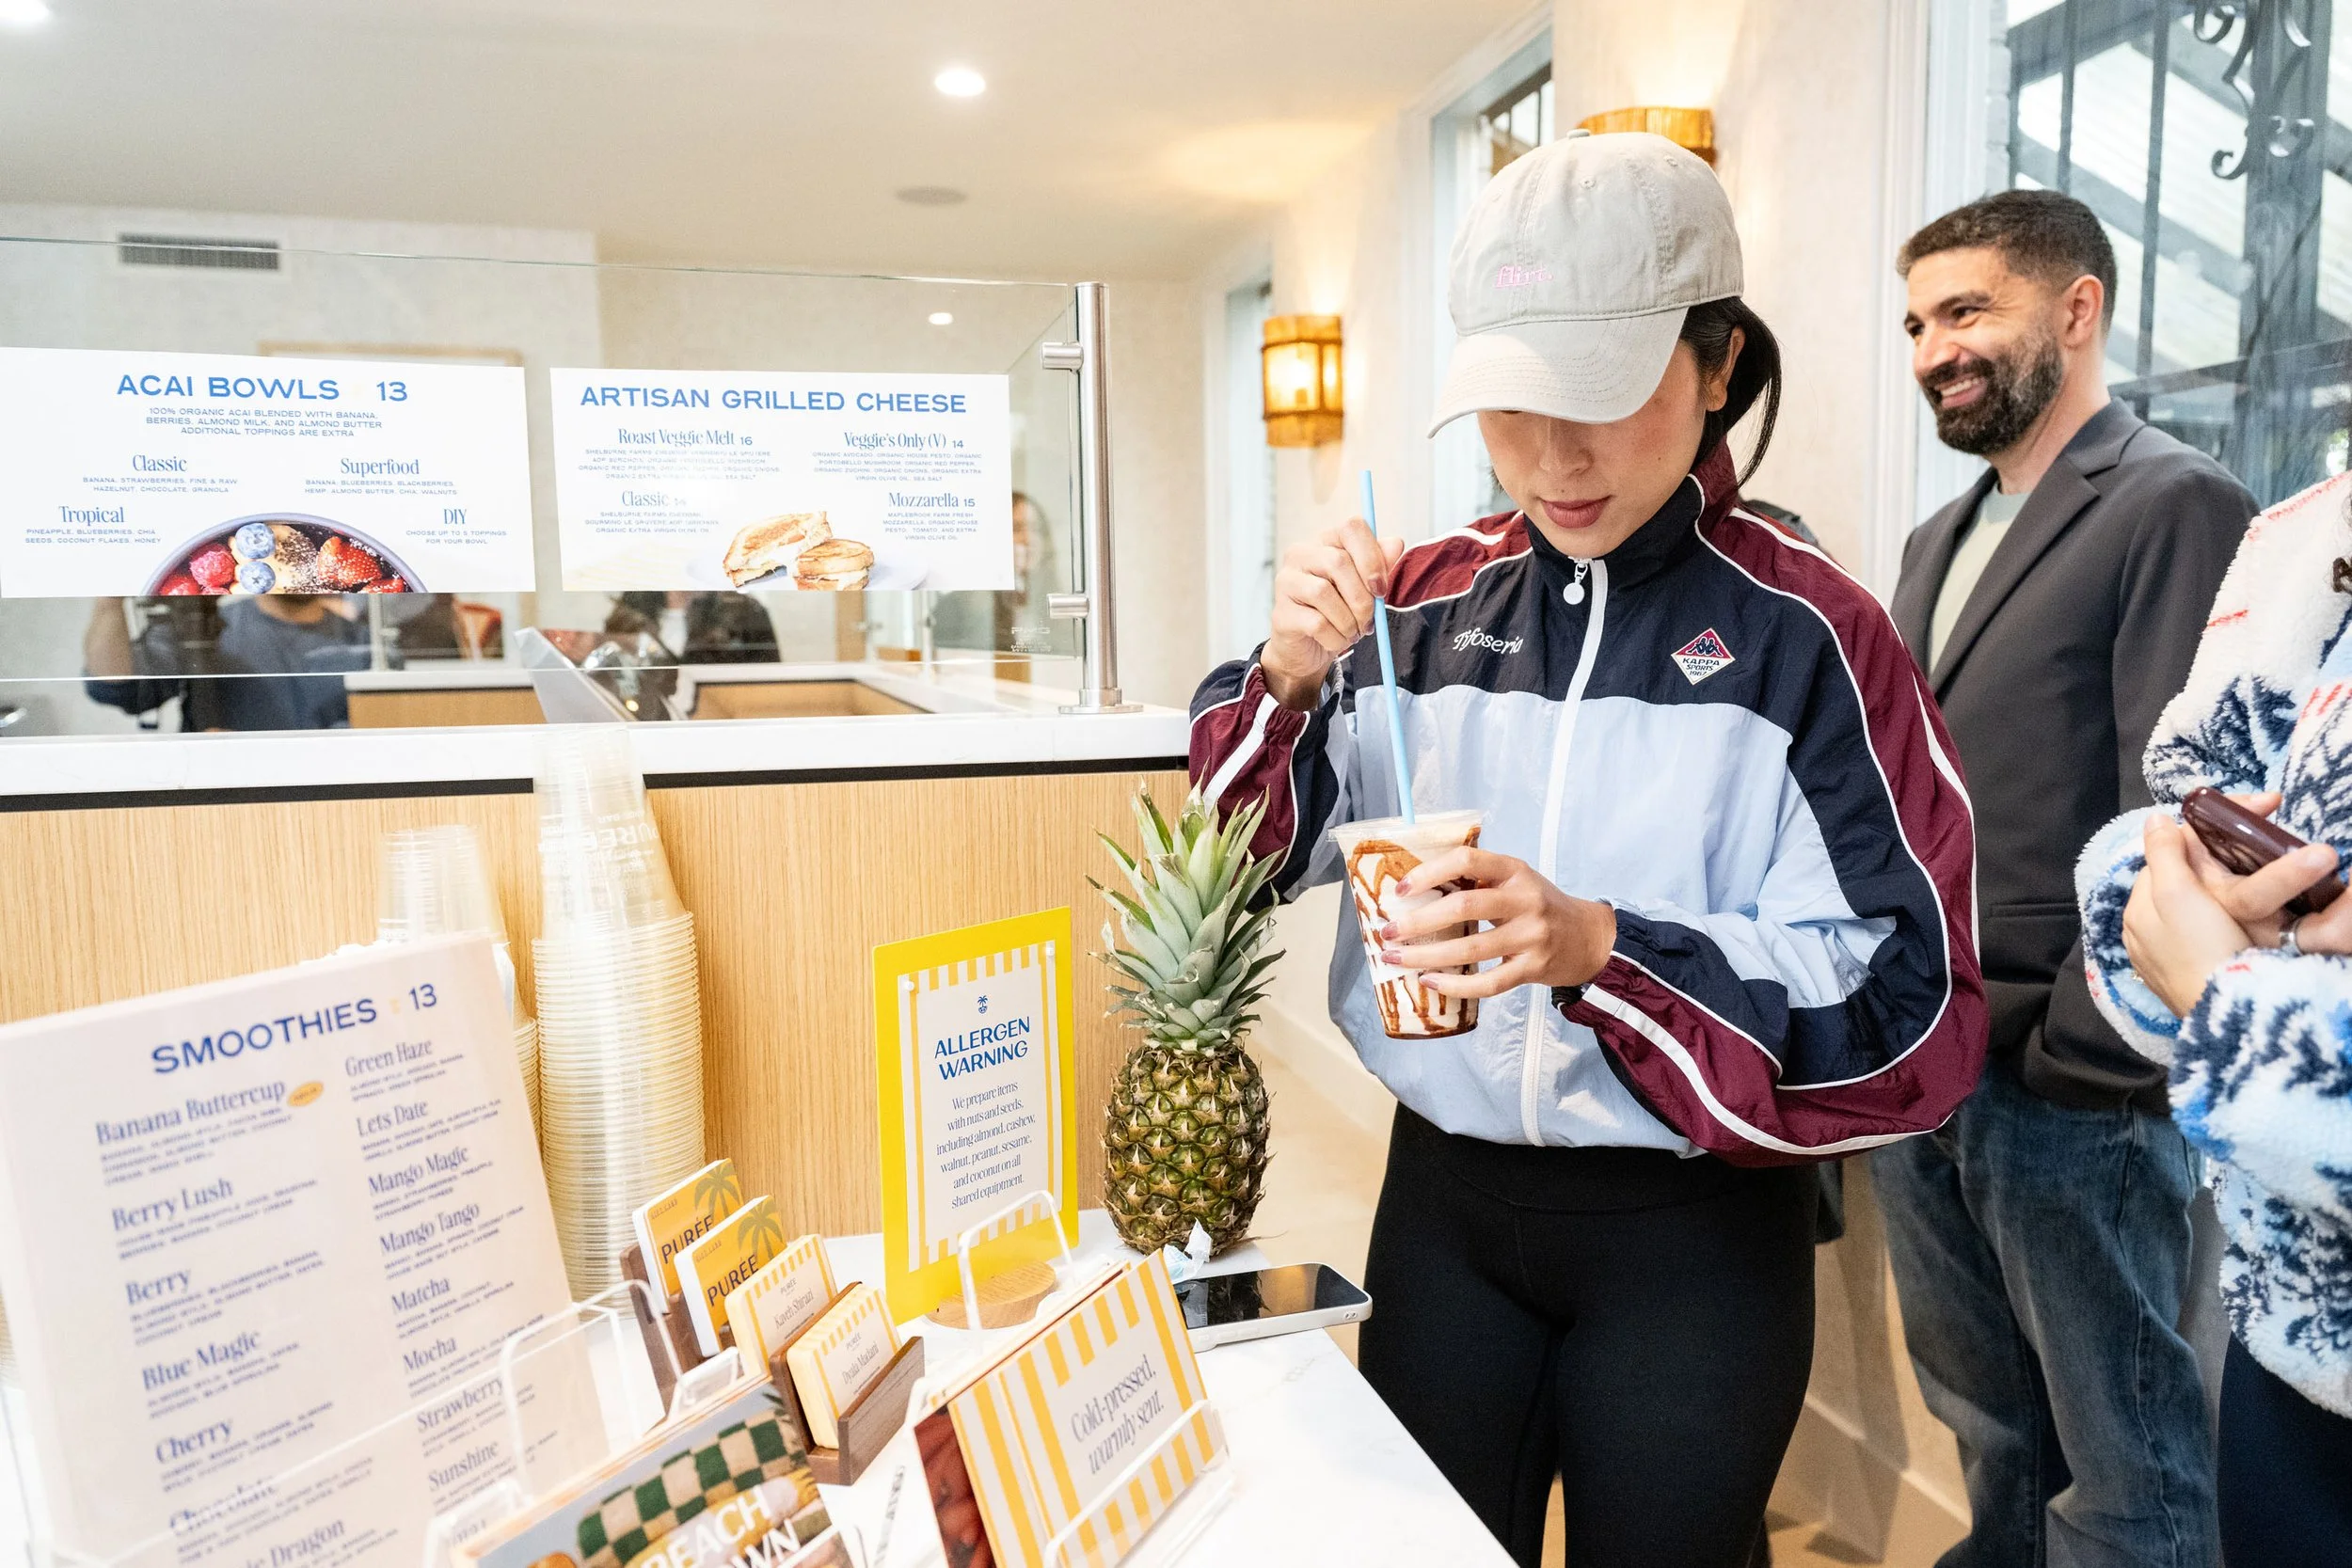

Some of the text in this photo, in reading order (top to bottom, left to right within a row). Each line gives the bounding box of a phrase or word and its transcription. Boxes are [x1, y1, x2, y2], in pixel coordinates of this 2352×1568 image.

[116, 374, 408, 402] ACAI BOWLS 13
[580, 387, 967, 414] ARTISAN GRILLED CHEESE
[180, 408, 225, 417] ORGANIC
[254, 409, 302, 418] BLENDED
[198, 418, 240, 426] ALMOND
[274, 419, 294, 427] AND
[298, 420, 340, 428] ALMOND
[181, 427, 241, 436] ADDITIONAL
[245, 428, 295, 436] TOPPINGS
[322, 429, 355, 437] EXTRA
[618, 428, 754, 448] Roast Veggie Melt 16
[844, 432, 964, 451] Veggie's Only (V) 14
[132, 454, 188, 472] Classic
[340, 457, 420, 477] Superfood
[58, 505, 125, 526] Tropical
[443, 508, 467, 525] DIY
[621, 490, 669, 507] Classic
[889, 493, 976, 509] Mozzarella 15
[1682, 657, 1720, 666] KAPPA
[151, 983, 438, 1074] SMOOTHIES 13
[934, 1016, 1030, 1059] ALLERGEN
[345, 1051, 394, 1078] Green
[395, 1038, 434, 1064] Haze
[939, 1040, 1028, 1080] WARNING
[95, 1107, 183, 1146] Banana
[185, 1080, 287, 1122] Buttercup
[952, 1082, 1018, 1110] We prepare items
[356, 1112, 393, 1138] Lets
[393, 1100, 429, 1126] Date
[947, 1116, 966, 1131] with
[966, 1111, 984, 1126] nuts
[984, 1104, 1000, 1120] and
[936, 1134, 975, 1156] including
[367, 1163, 424, 1196] Mango
[425, 1146, 470, 1176] Magic
[953, 1153, 1021, 1189] and coconut on all
[111, 1196, 178, 1233] Berry
[181, 1176, 234, 1212] Lush
[952, 1188, 979, 1209] shared
[379, 1220, 436, 1257] Mango
[436, 1202, 481, 1233] Tango
[125, 1268, 192, 1307] Berry
[391, 1275, 452, 1315] Matcha
[707, 1254, 759, 1307] PURÉE
[141, 1356, 192, 1392] Blue
[196, 1329, 262, 1370] Magic
[402, 1335, 459, 1374] Mocha
[415, 1375, 505, 1434] Strawberry
[155, 1418, 233, 1465] Cherry
[1089, 1412, 1136, 1475] warmly
[428, 1440, 501, 1493] Sunshine
[269, 1518, 345, 1568] Dragon
